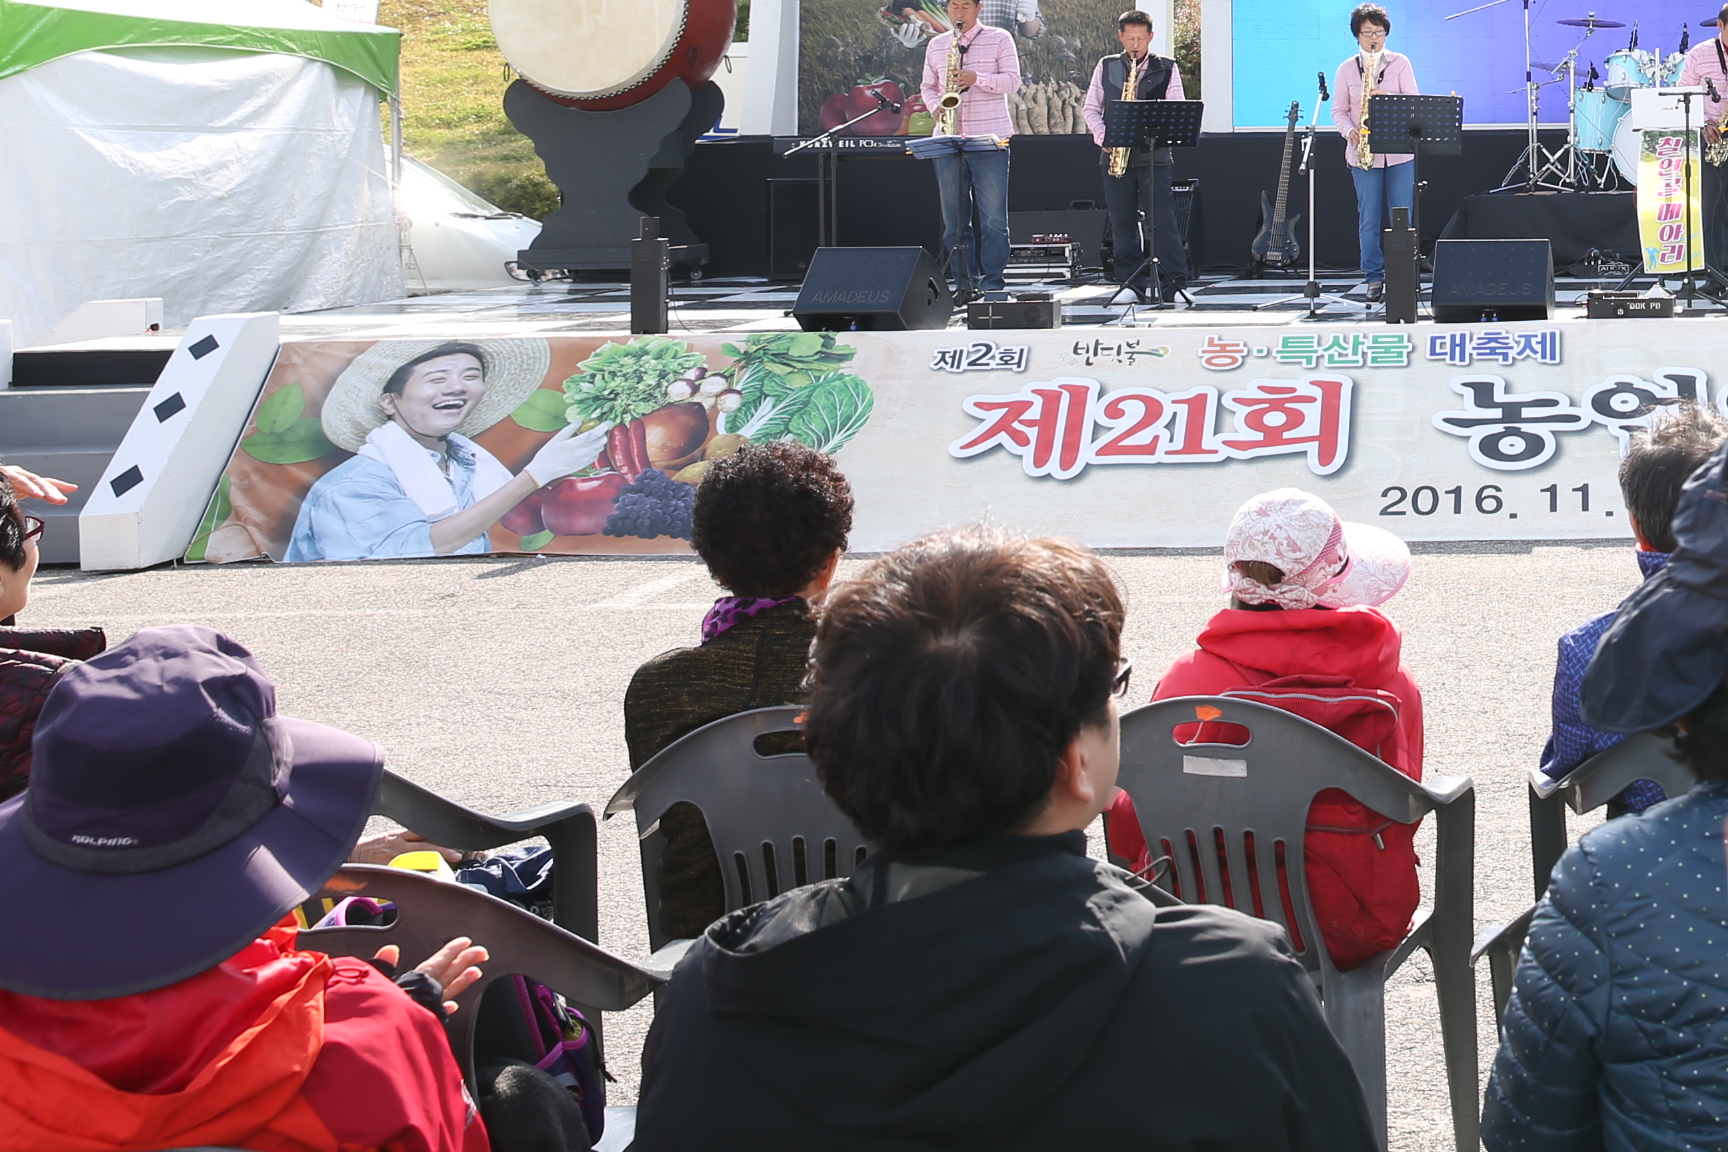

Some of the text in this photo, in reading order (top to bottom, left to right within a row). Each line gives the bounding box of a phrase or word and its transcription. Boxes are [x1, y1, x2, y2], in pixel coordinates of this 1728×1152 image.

[1656, 202, 1685, 264] 메아리
[810, 290, 890, 304] AMADEUS
[1447, 282, 1532, 296] AMADEUS
[932, 342, 1024, 369] 제2회
[1201, 334, 1413, 368] 농·특산물
[1429, 331, 1557, 363] 대축제
[959, 380, 1344, 472] 제21회
